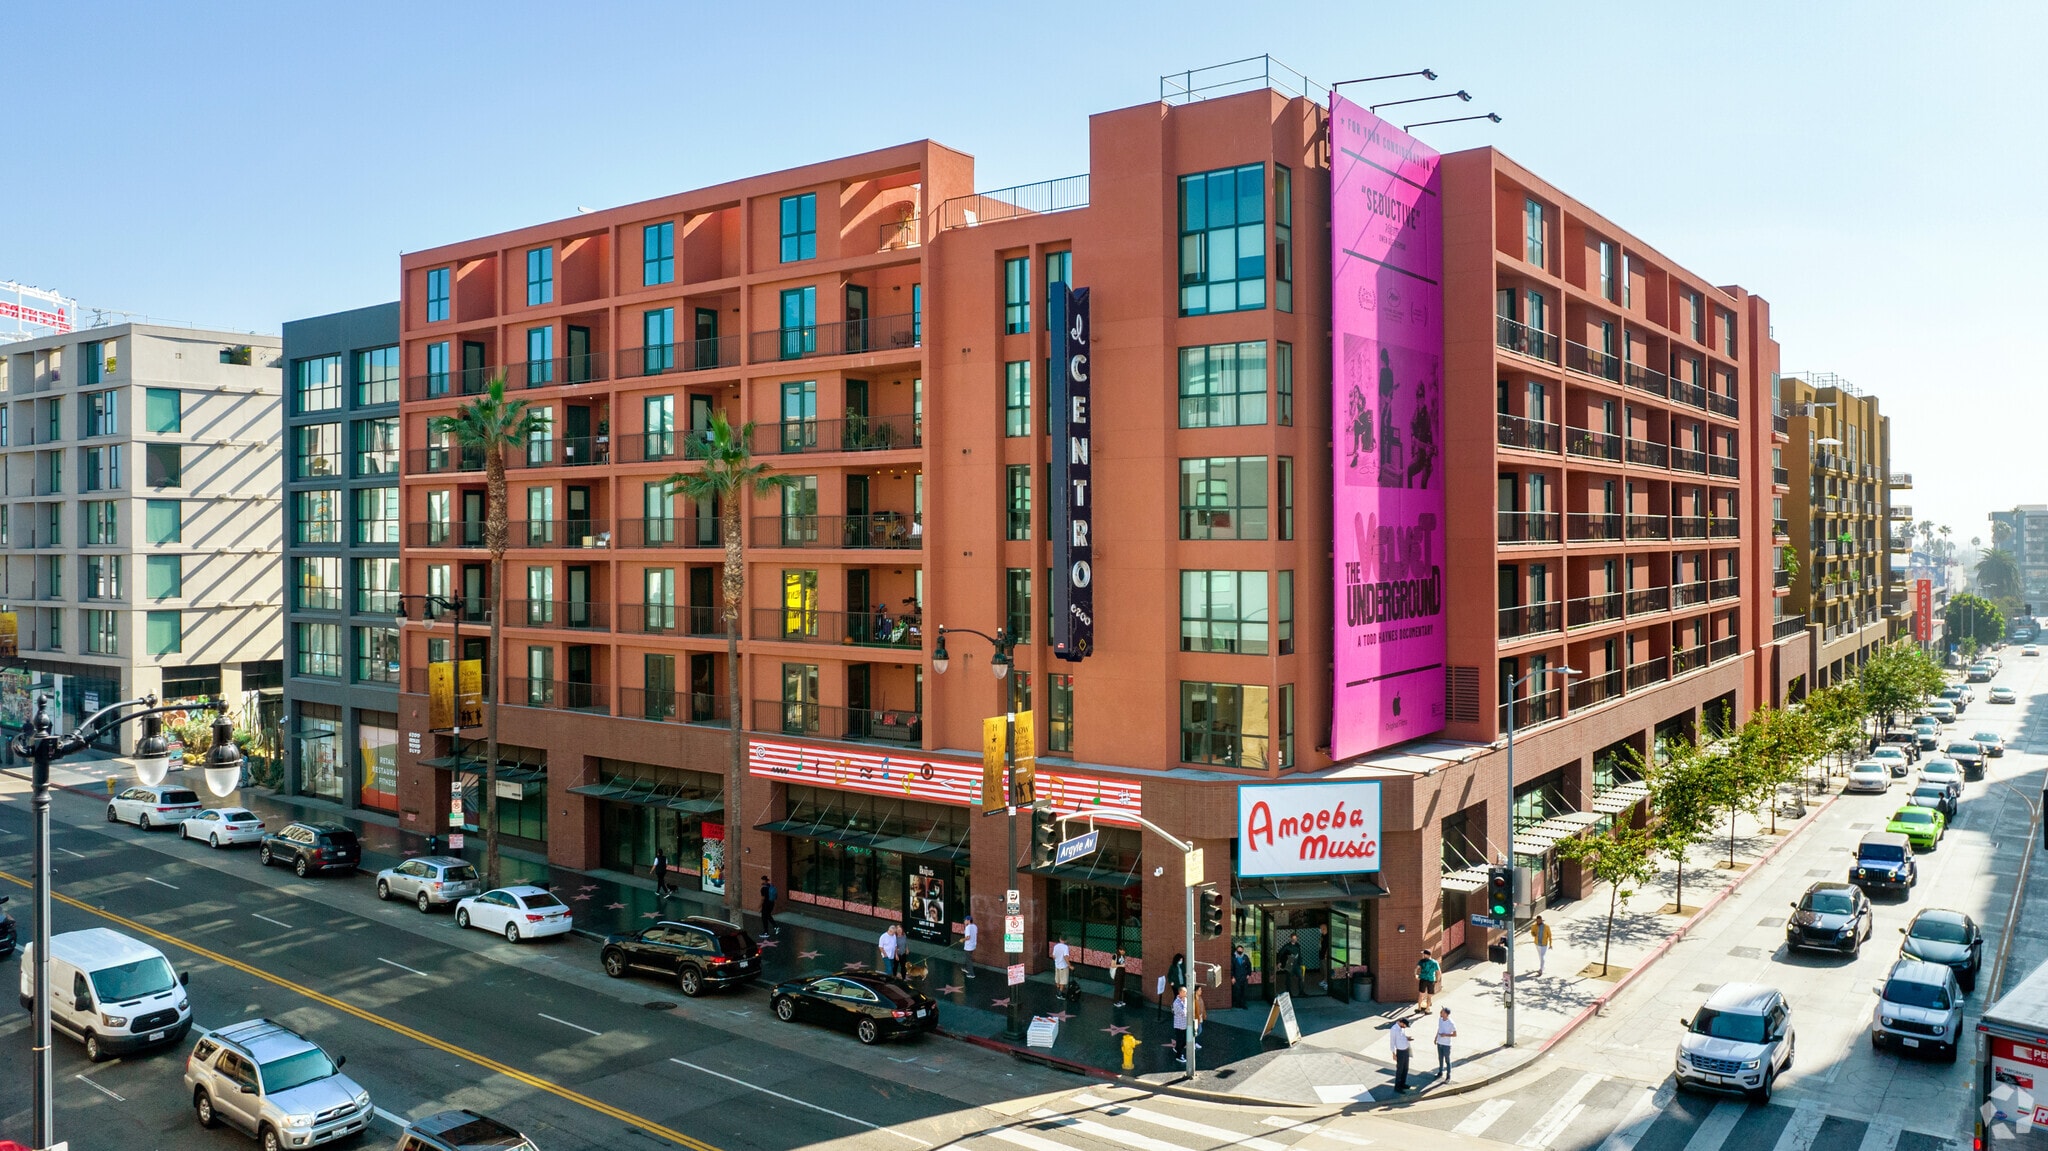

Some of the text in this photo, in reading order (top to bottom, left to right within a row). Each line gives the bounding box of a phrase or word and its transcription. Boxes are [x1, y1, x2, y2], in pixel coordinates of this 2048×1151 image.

[1347, 118, 1430, 172] FOR YOUR CONSIDERATION
[1071, 354, 1091, 589] CENTRO
[1354, 511, 1437, 583] VELVET
[1345, 561, 1361, 584] THE
[1346, 565, 1441, 627] UNDERGROUND
[1070, 603, 1091, 626] 6200
[1357, 624, 1434, 647] A TODD HAYNES DOCUMENTARY
[1014, 726, 1029, 735] NOW
[379, 756, 396, 766] RETAIL
[1248, 801, 1363, 852] Amoeba
[1060, 837, 1094, 858] Argyle Av
[1299, 832, 1376, 860] Music
[2004, 1067, 2034, 1077] PERFORMANCE
